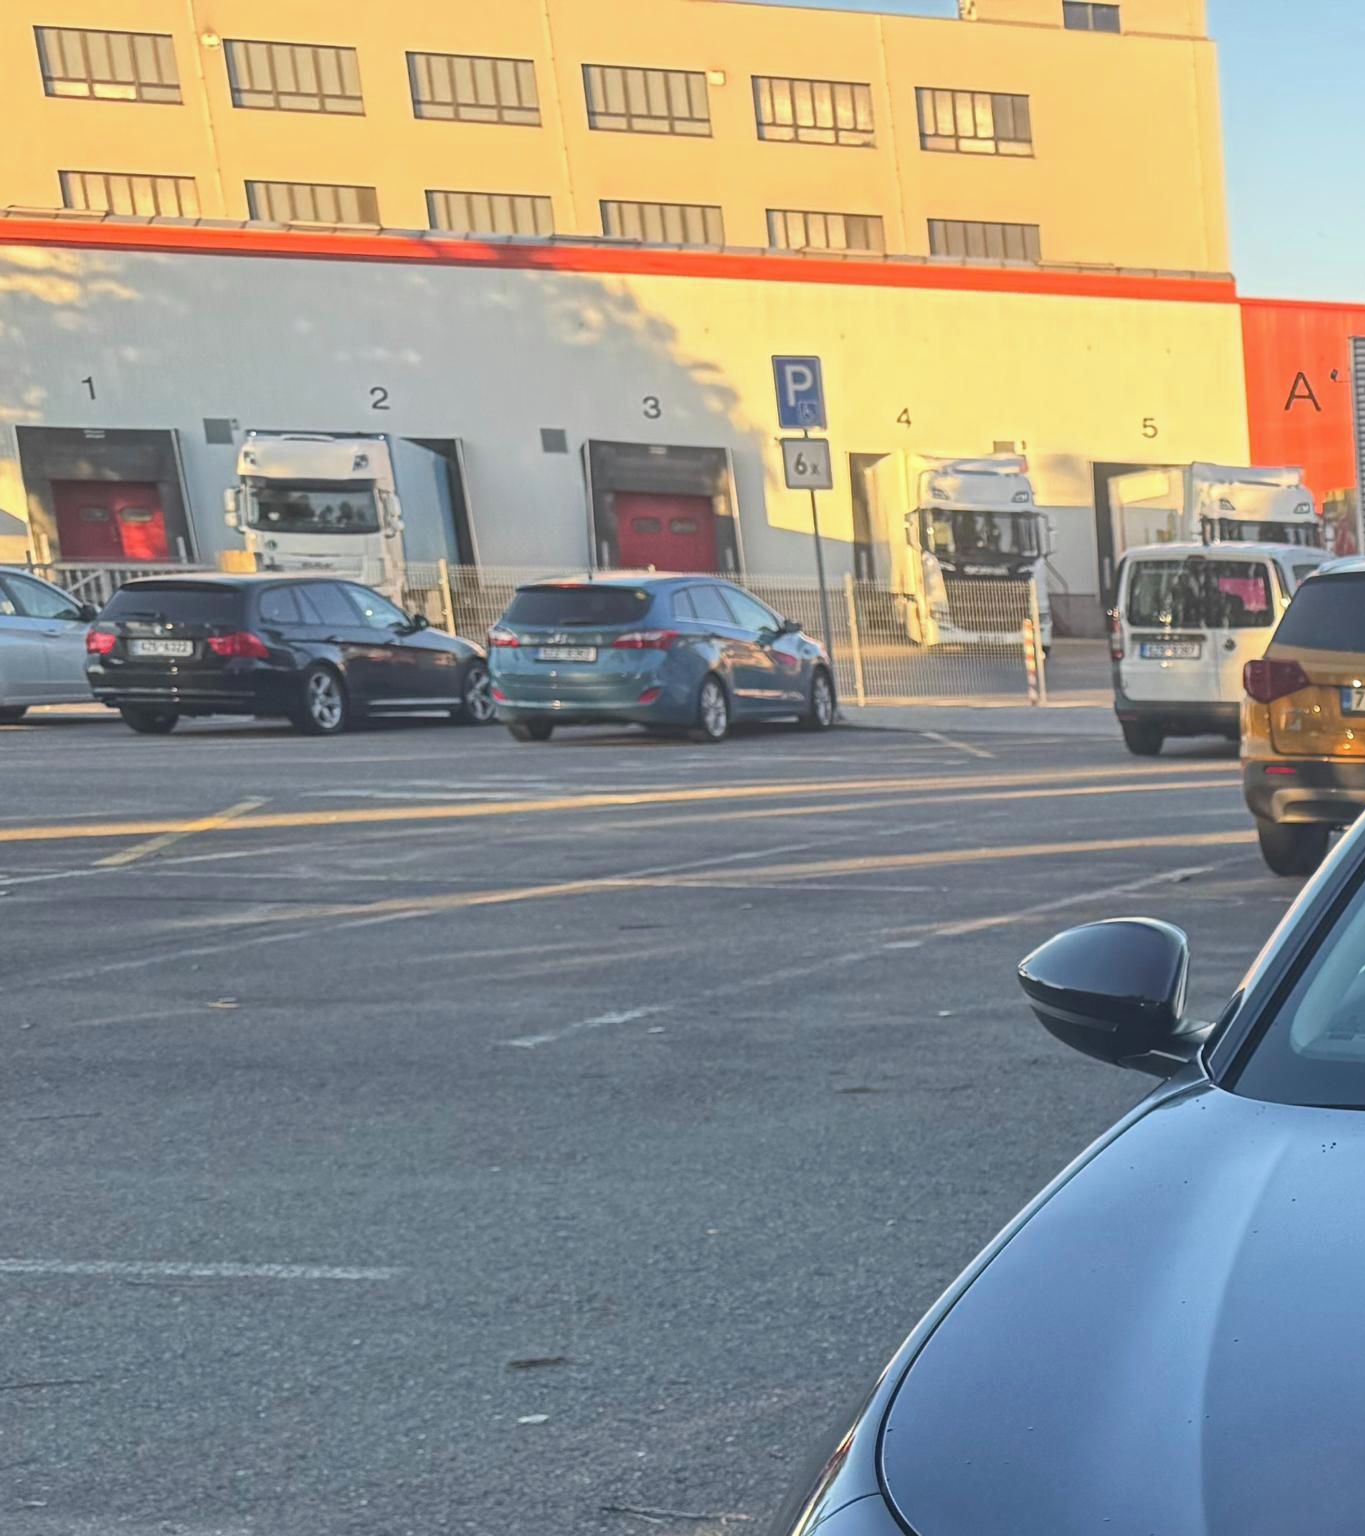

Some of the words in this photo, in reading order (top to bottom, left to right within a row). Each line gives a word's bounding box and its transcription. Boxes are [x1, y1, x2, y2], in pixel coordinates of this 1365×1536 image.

[81, 376, 96, 400] 1
[784, 364, 814, 407] P
[1284, 371, 1322, 412] A
[370, 386, 391, 410] 2
[642, 396, 662, 420] 3
[896, 407, 912, 430] 4
[1142, 417, 1158, 439] 5
[794, 452, 821, 476] 6x
